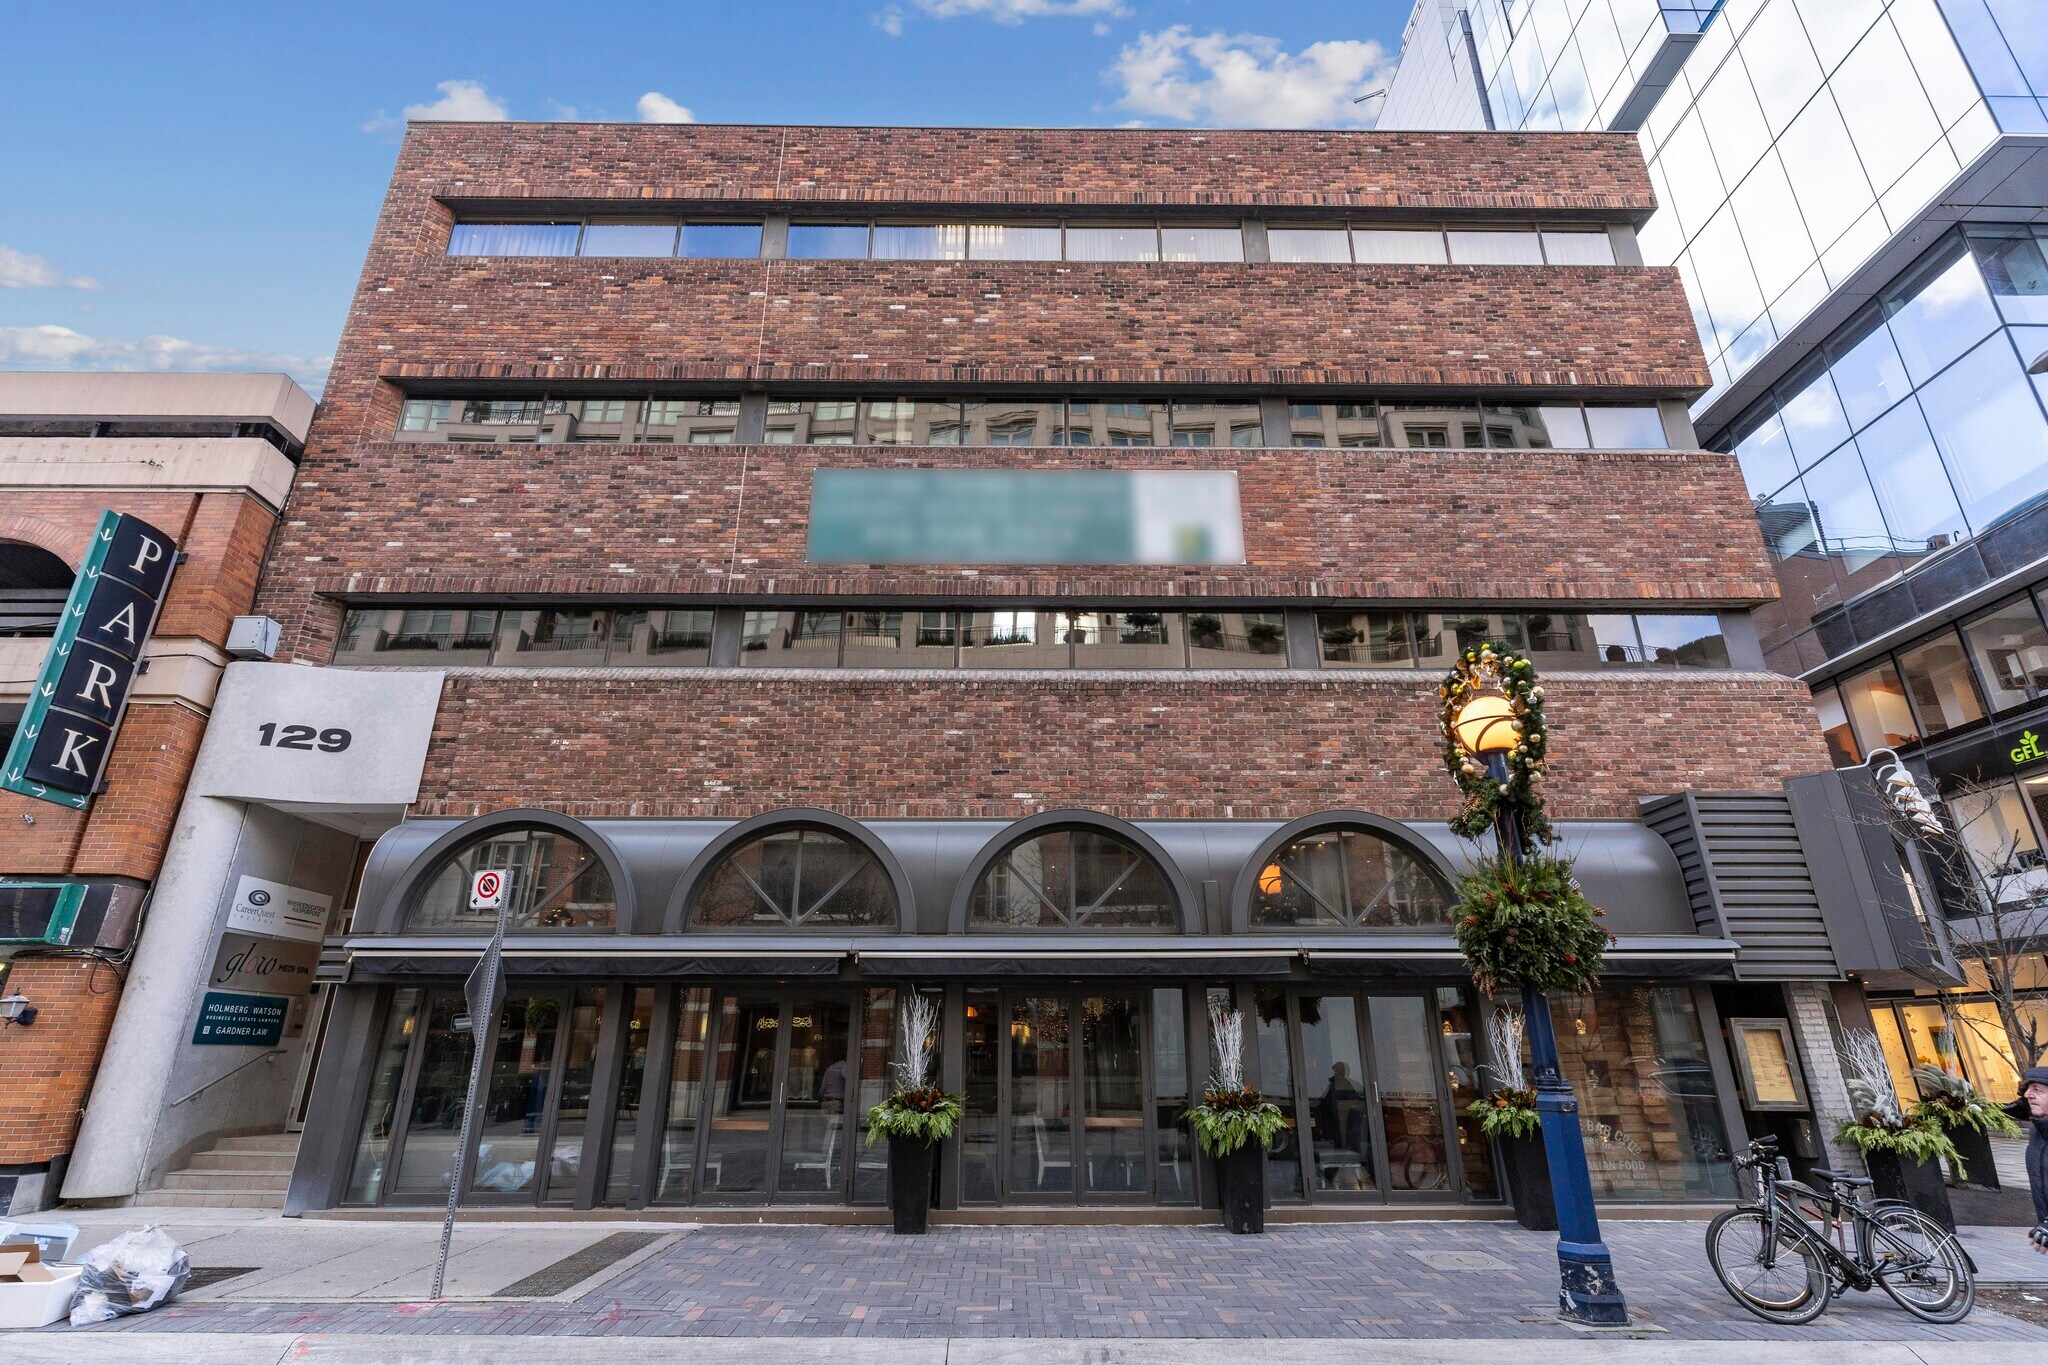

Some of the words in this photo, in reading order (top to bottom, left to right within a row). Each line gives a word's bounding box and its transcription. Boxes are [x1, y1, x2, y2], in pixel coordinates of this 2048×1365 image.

[51, 533, 162, 778] PARK
[258, 722, 352, 753] 129
[2010, 731, 2045, 763] GFL
[236, 902, 275, 918] CareerQuest
[300, 902, 326, 913] EDUCATION
[301, 908, 321, 918] PURPOSE
[234, 914, 273, 925] COLLEGE
[217, 942, 278, 983] glow
[279, 964, 295, 973] MEDI
[297, 966, 309, 975] SPA
[208, 1004, 249, 1014] HOLMBERG
[253, 1007, 282, 1016] WATSON
[215, 1026, 251, 1035] GARDNER
[252, 1028, 269, 1036] LAW
[1586, 1119, 1612, 1137] BAR
[1587, 1160, 1617, 1171] ALIAN
[1619, 1160, 1646, 1171] FOOD
